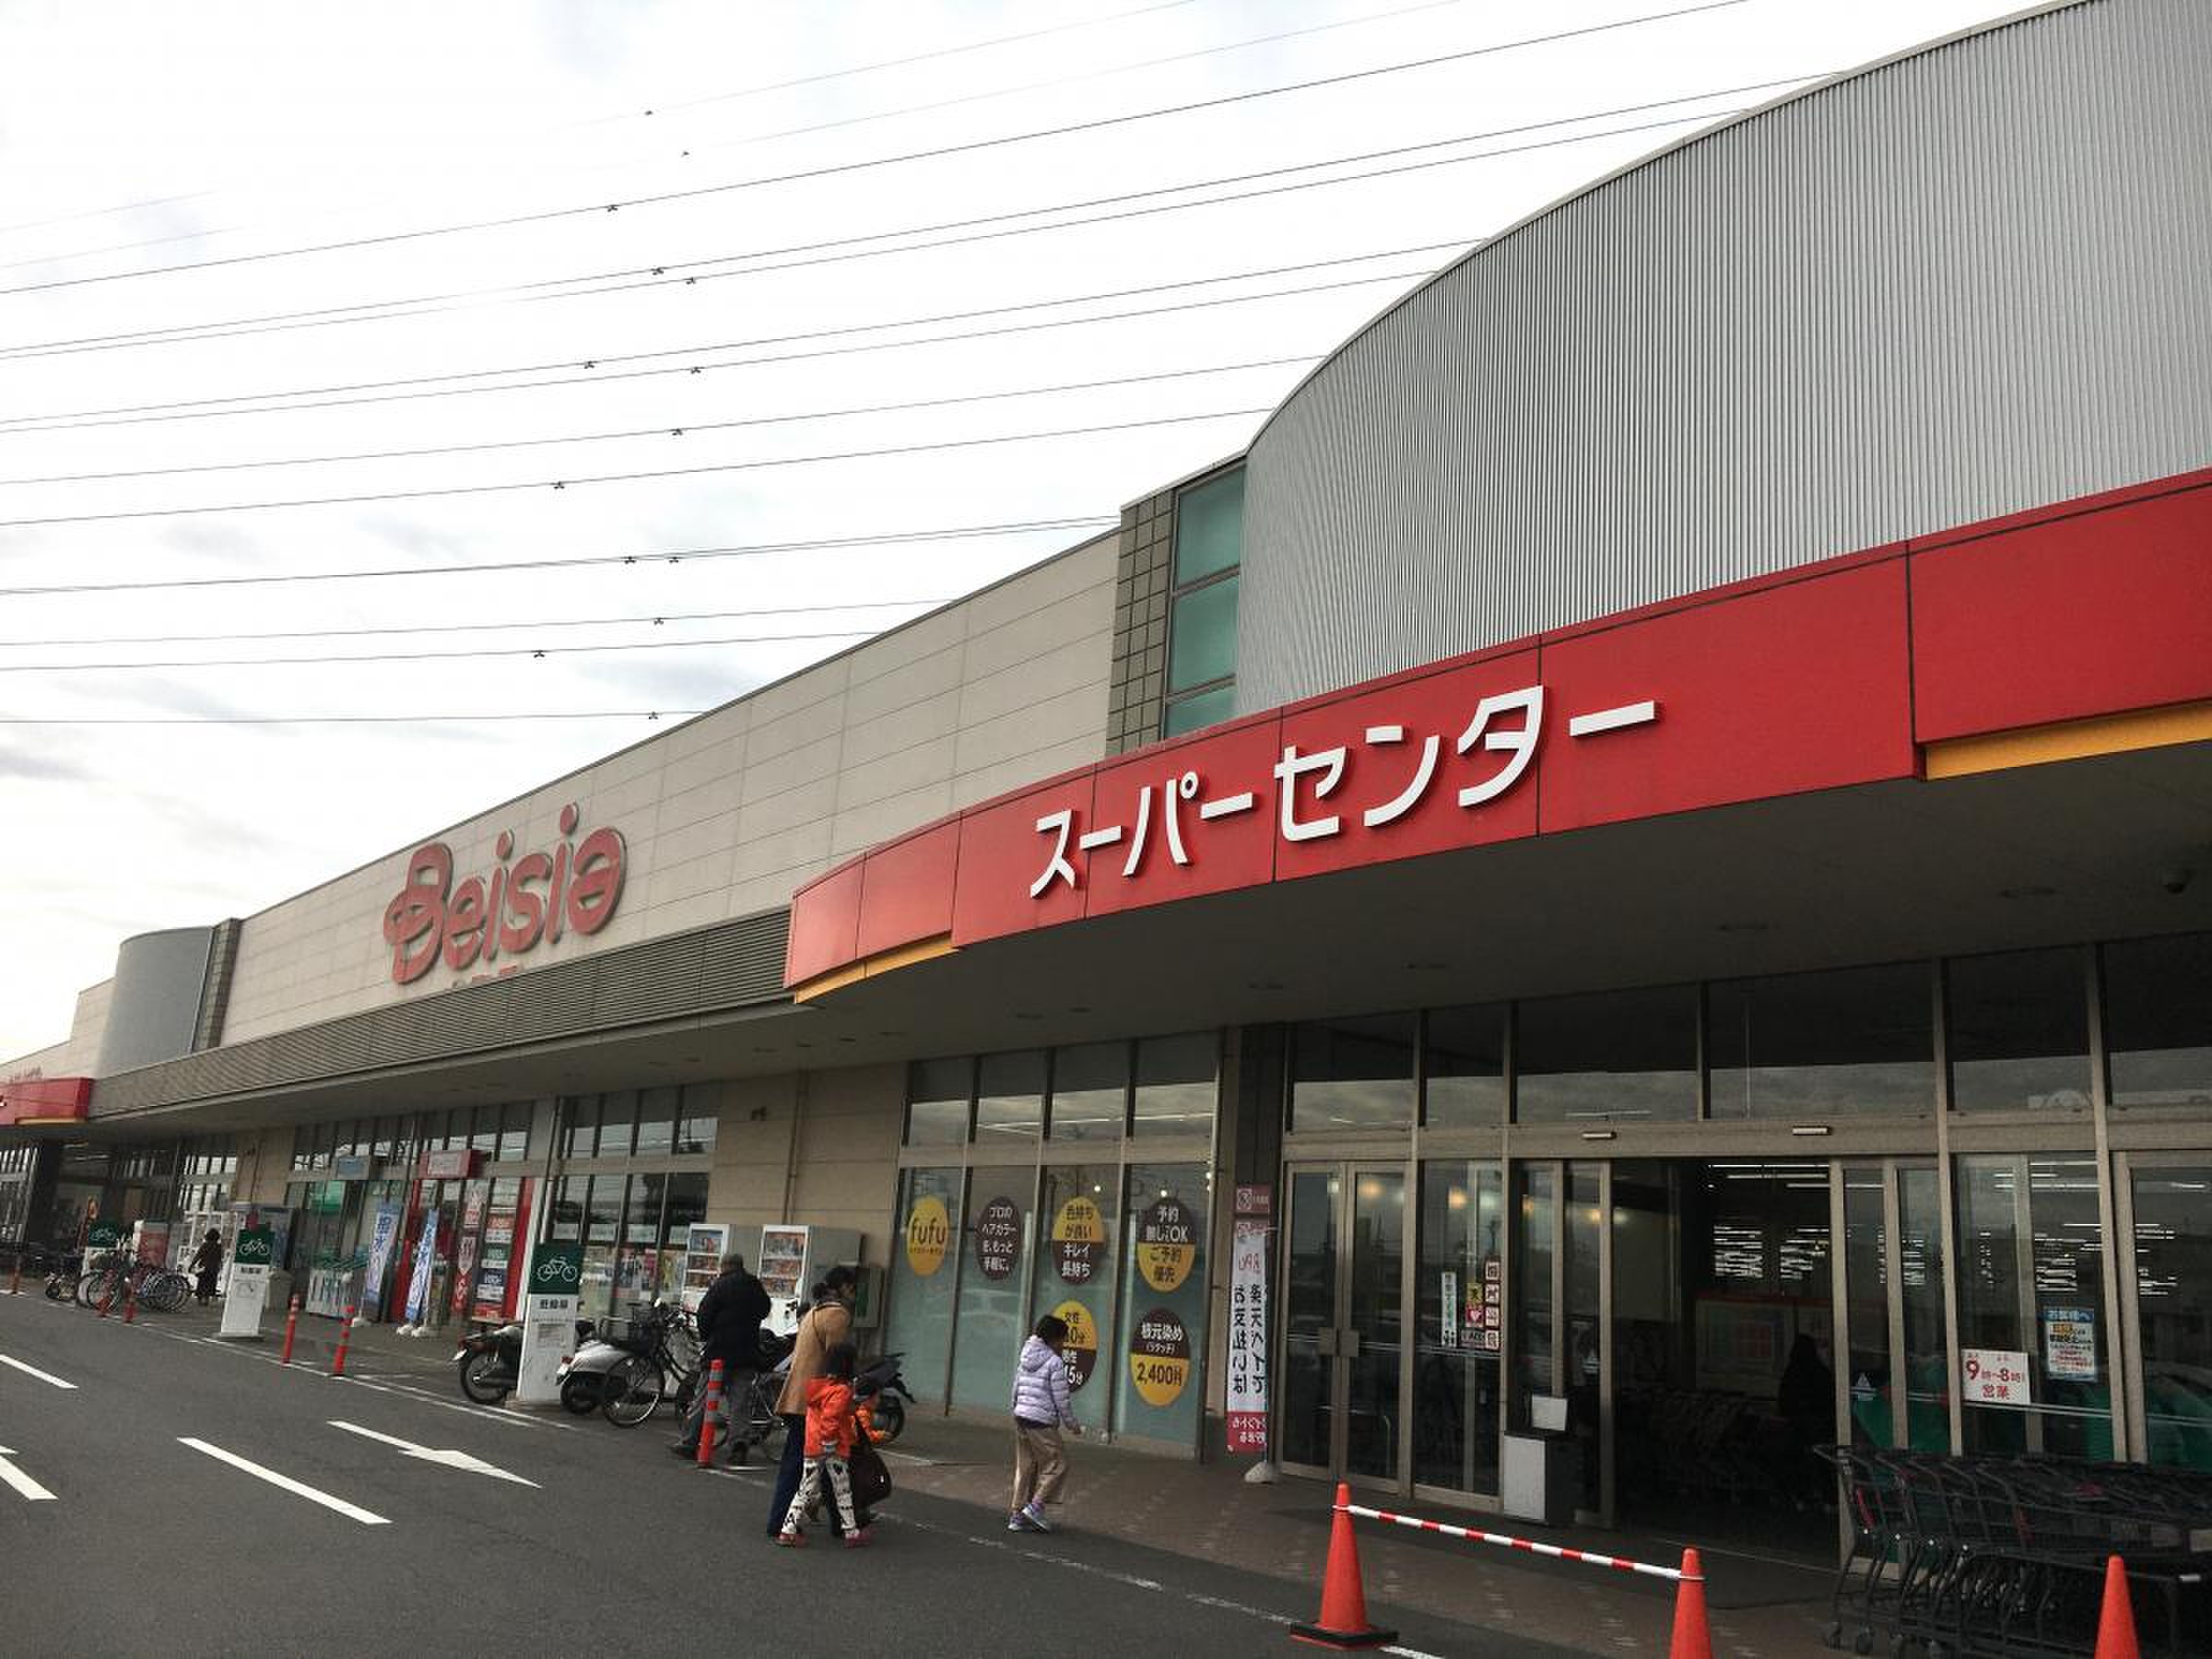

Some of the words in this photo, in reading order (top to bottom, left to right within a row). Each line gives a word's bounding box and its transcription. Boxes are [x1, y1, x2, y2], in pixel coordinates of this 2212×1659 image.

[1030, 685, 1658, 899] スーパーセンター
[383, 803, 627, 984] Beisia
[1158, 1206, 1180, 1223] 予約
[911, 1218, 946, 1244] fufu
[1063, 1243, 1089, 1259] キレイ
[1151, 1246, 1182, 1264] ご予約
[1062, 1260, 1091, 1278] 長持ち
[1141, 1322, 1183, 1341] 根元染め
[1136, 1361, 1182, 1386] 2,400円
